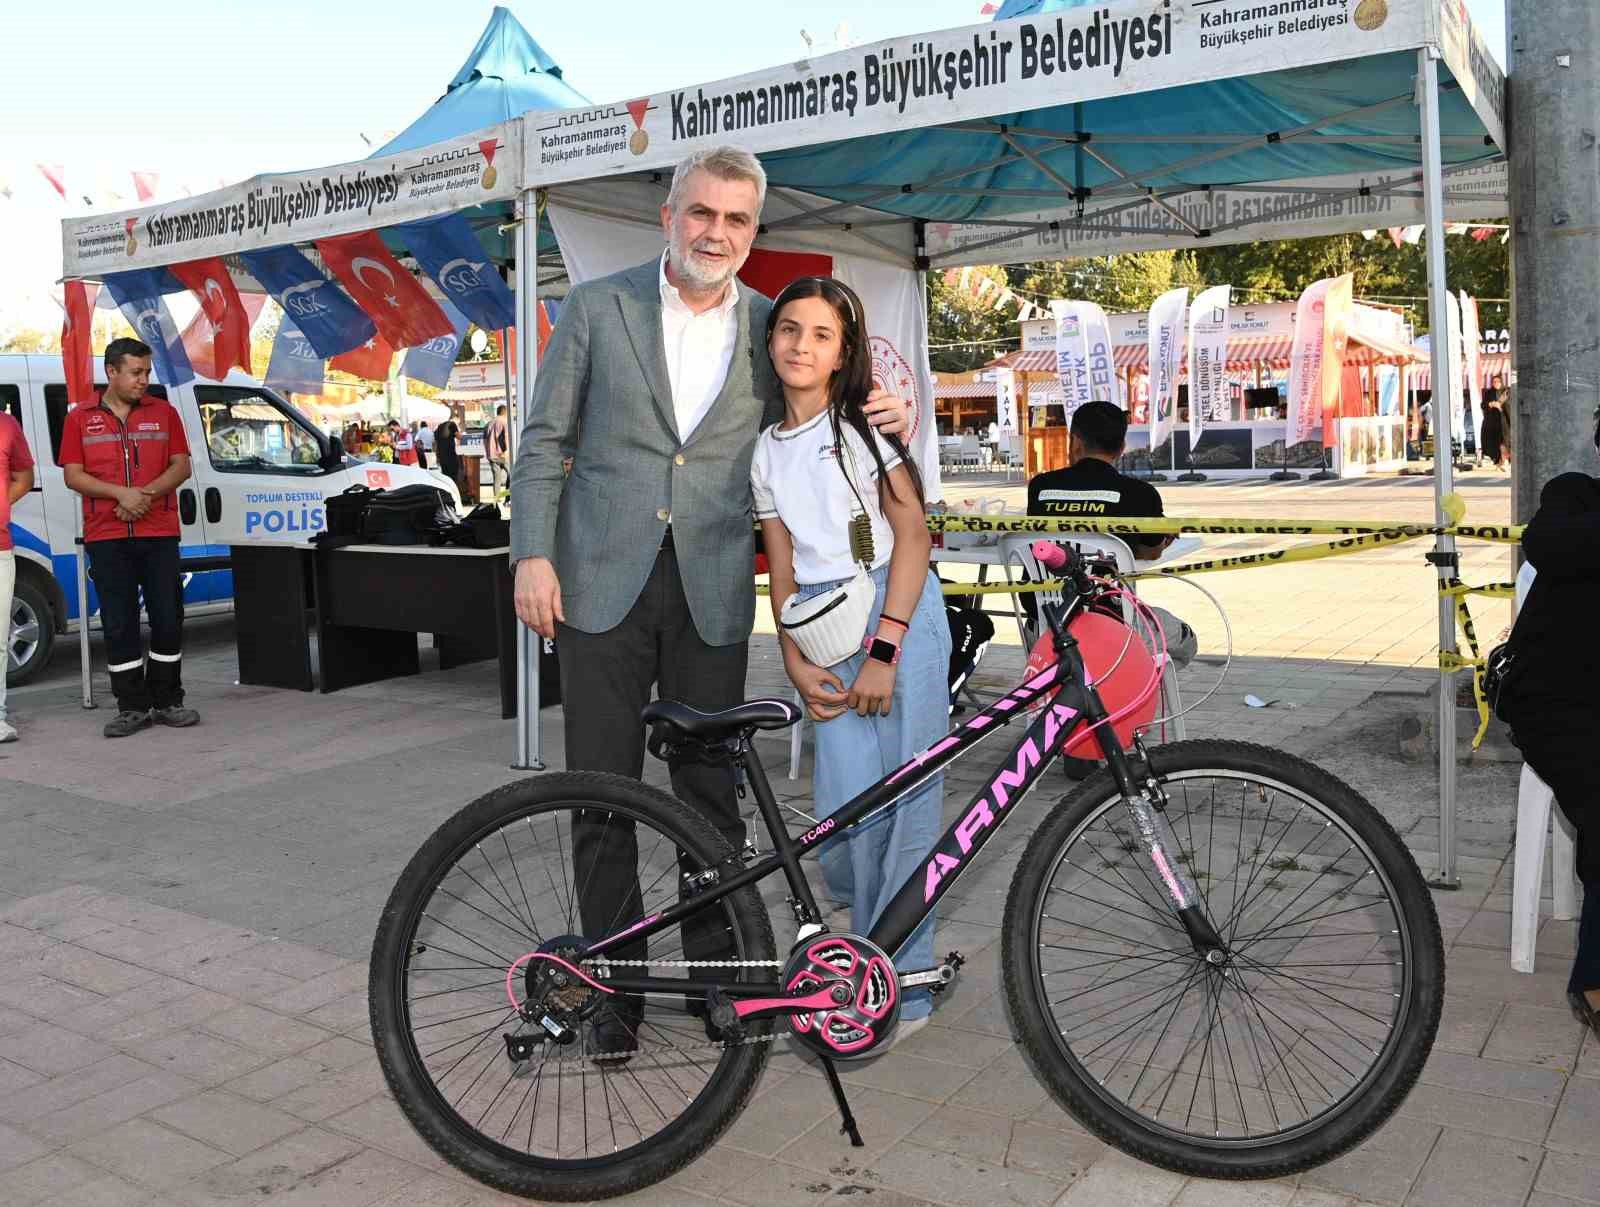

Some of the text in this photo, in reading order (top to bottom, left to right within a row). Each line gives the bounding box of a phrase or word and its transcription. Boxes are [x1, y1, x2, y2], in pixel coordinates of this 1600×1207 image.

[1200, 9, 1348, 48] Büyükşehir Belediyesi
[671, 0, 1171, 140] Kahramanmaraş Büyükşehir Belediyesi
[541, 124, 627, 148] Kahramanmaraş
[541, 140, 627, 165] Büyükşehir Belediyesi
[410, 162, 480, 185] Kahramanmaraş
[146, 164, 399, 248] Kahramanmaraş Büyükşehir Belediyesi
[246, 494, 283, 503] TOPLUM
[1045, 501, 1105, 513] TUBİM
[246, 503, 324, 534] POLİS
[924, 702, 1079, 905] ARMA
[799, 818, 835, 844] TC400
